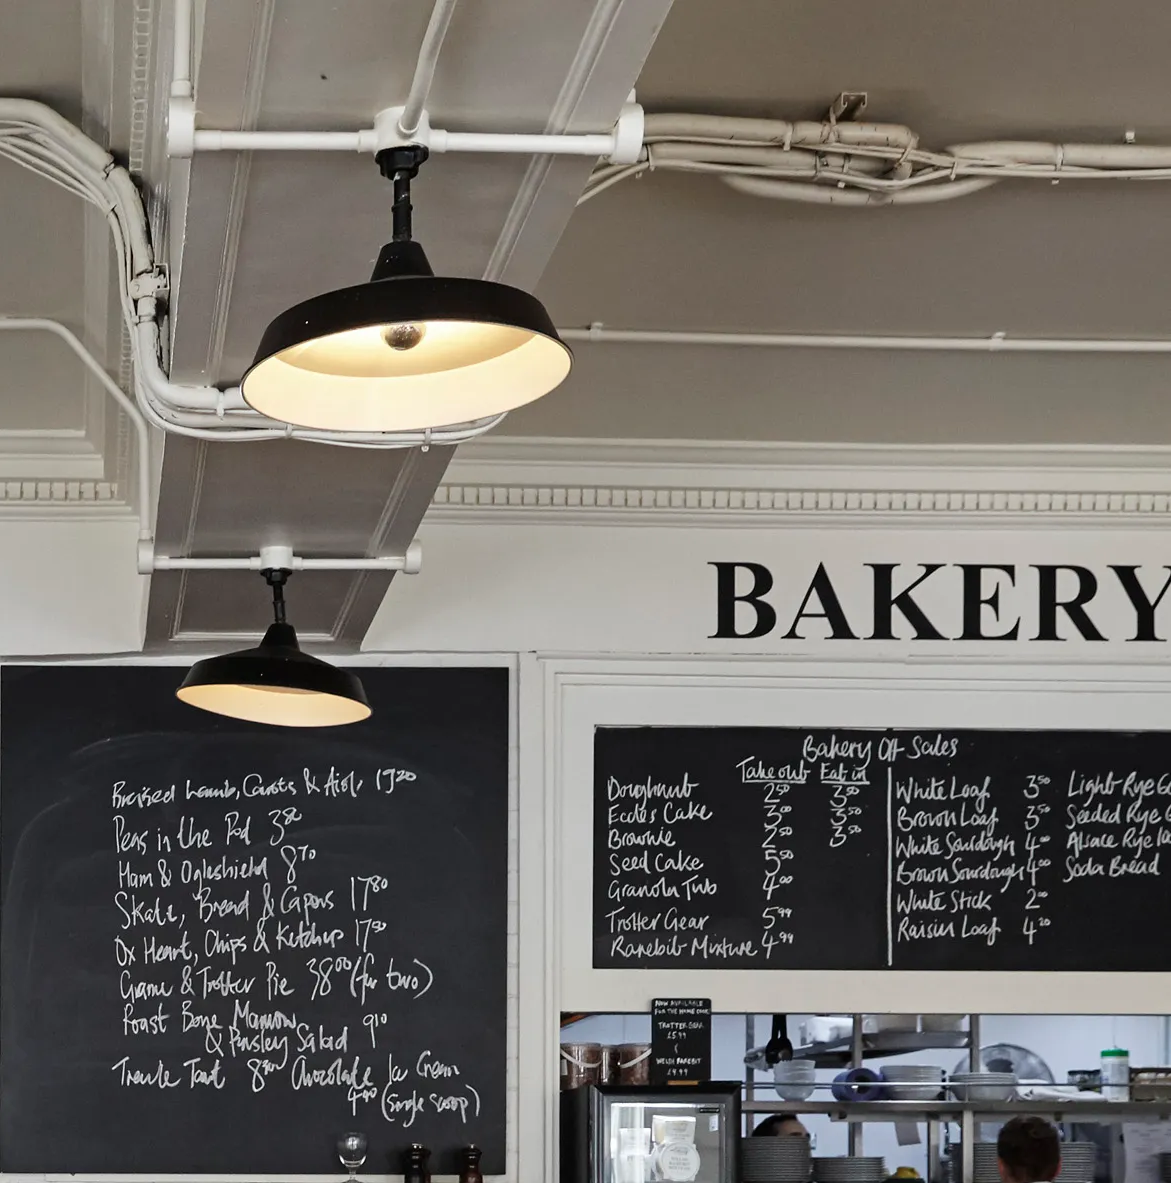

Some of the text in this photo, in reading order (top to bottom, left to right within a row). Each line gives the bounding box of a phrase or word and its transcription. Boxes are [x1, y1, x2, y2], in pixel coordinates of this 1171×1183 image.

[707, 561, 1171, 642] BAKERY
[736, 756, 775, 782] Take
[803, 733, 959, 770] Bakery Off Sales
[112, 781, 175, 808] Braised
[304, 767, 320, 795] &
[820, 762, 867, 781] Eat in
[1067, 769, 1155, 807] Light Rye
[608, 772, 700, 811] Doughnut
[896, 776, 947, 804] White
[950, 775, 991, 814] Loaf
[609, 803, 657, 824] Eccles
[664, 801, 713, 824] Cake
[897, 806, 956, 832] Brown
[961, 802, 999, 837] Loaf
[1065, 803, 1121, 830] Seeded
[1126, 800, 1162, 835] Rye
[113, 815, 148, 855] Peas
[157, 828, 171, 852] in
[177, 816, 212, 848] the
[225, 811, 251, 846] Pod
[608, 826, 676, 850] Brownie
[896, 834, 944, 859] White
[944, 830, 1016, 861] Sourdough
[1066, 827, 1154, 859] Alsace Rye
[117, 860, 153, 888] Ham
[158, 859, 172, 888] &
[609, 850, 651, 876] Seed
[654, 850, 704, 872] Cake
[896, 861, 949, 885] Brown
[949, 857, 1025, 893] Sourdough
[1062, 852, 1161, 883] Soda Bread
[199, 887, 249, 923] Bread
[263, 882, 276, 920] &
[608, 877, 680, 902] Granola
[681, 875, 717, 901] Tub
[896, 888, 947, 915] White
[950, 889, 992, 914] Stick
[605, 906, 661, 933] Trotter
[664, 907, 710, 931] Gear
[898, 916, 955, 943] Raisin
[961, 914, 1002, 946] Loaf
[115, 936, 136, 967] Ox
[205, 925, 248, 964] Chips
[253, 918, 270, 953] &
[276, 920, 344, 951] Ketchup
[611, 935, 688, 958] Rarebit
[691, 934, 758, 959] Mixture
[120, 970, 174, 1003] Game
[181, 965, 195, 996] &
[196, 966, 256, 999] Trotter
[266, 961, 295, 1001] Pie
[123, 999, 296, 1035] Roast Bone Marrow
[205, 1027, 224, 1057] &
[229, 1025, 288, 1070] Parsley
[296, 1022, 348, 1053] Salad
[112, 1056, 181, 1090] Treacle
[183, 1057, 226, 1090] Tart
[417, 1050, 460, 1079] Cream
